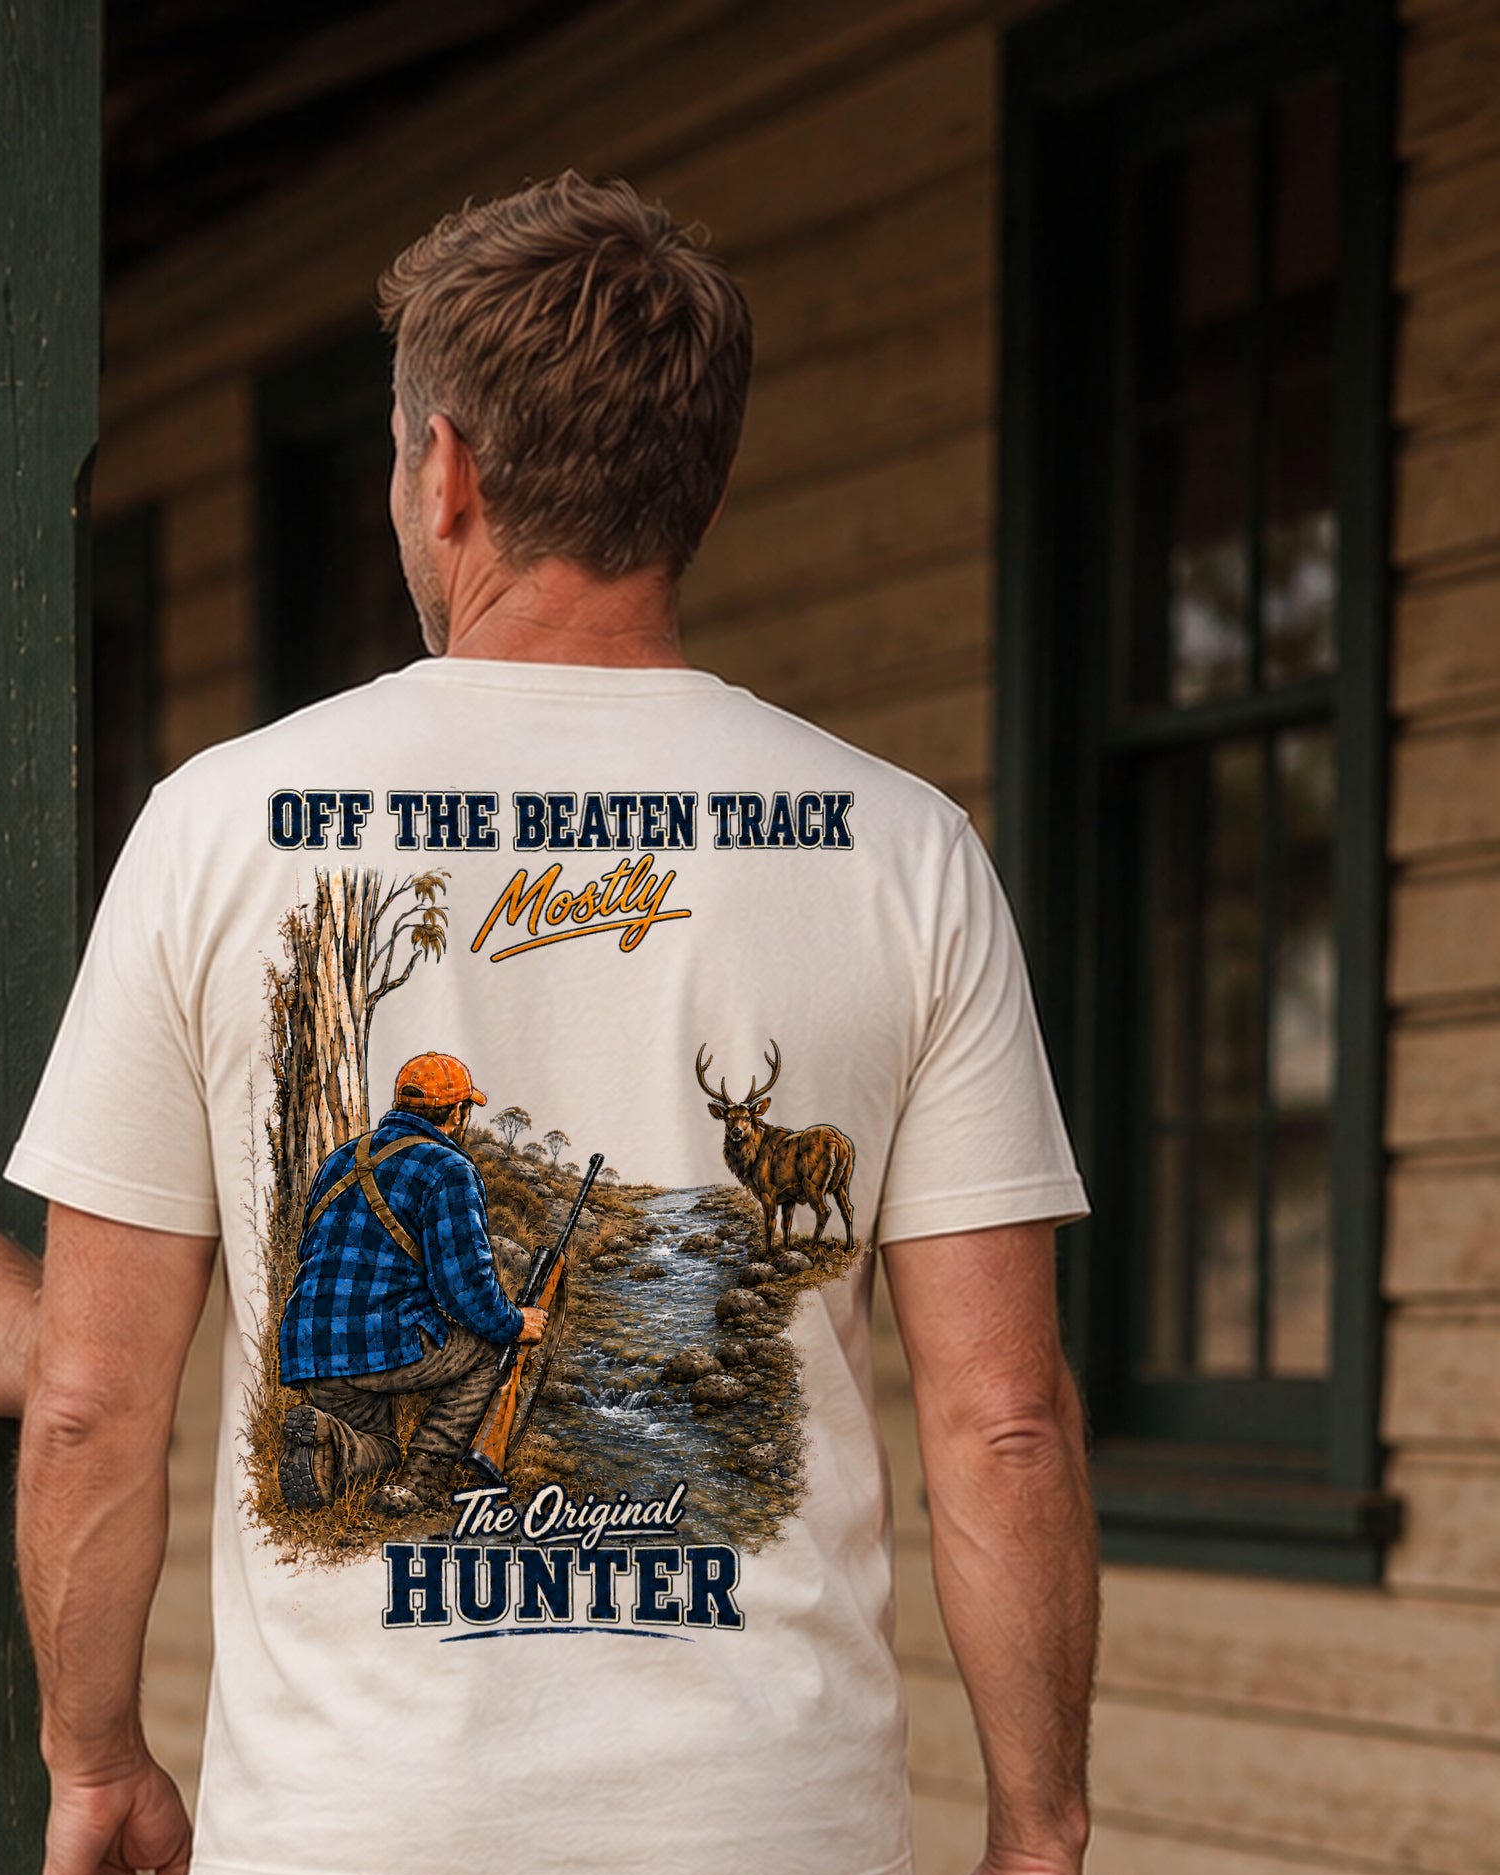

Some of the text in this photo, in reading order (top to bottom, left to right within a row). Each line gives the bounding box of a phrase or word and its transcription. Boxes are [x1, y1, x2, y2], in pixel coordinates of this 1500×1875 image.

[268, 788, 855, 850] OFF THE BEATEN TRACK
[470, 854, 692, 963] Mostly
[451, 1481, 688, 1550] The Original
[382, 1542, 745, 1629] HUNTER
